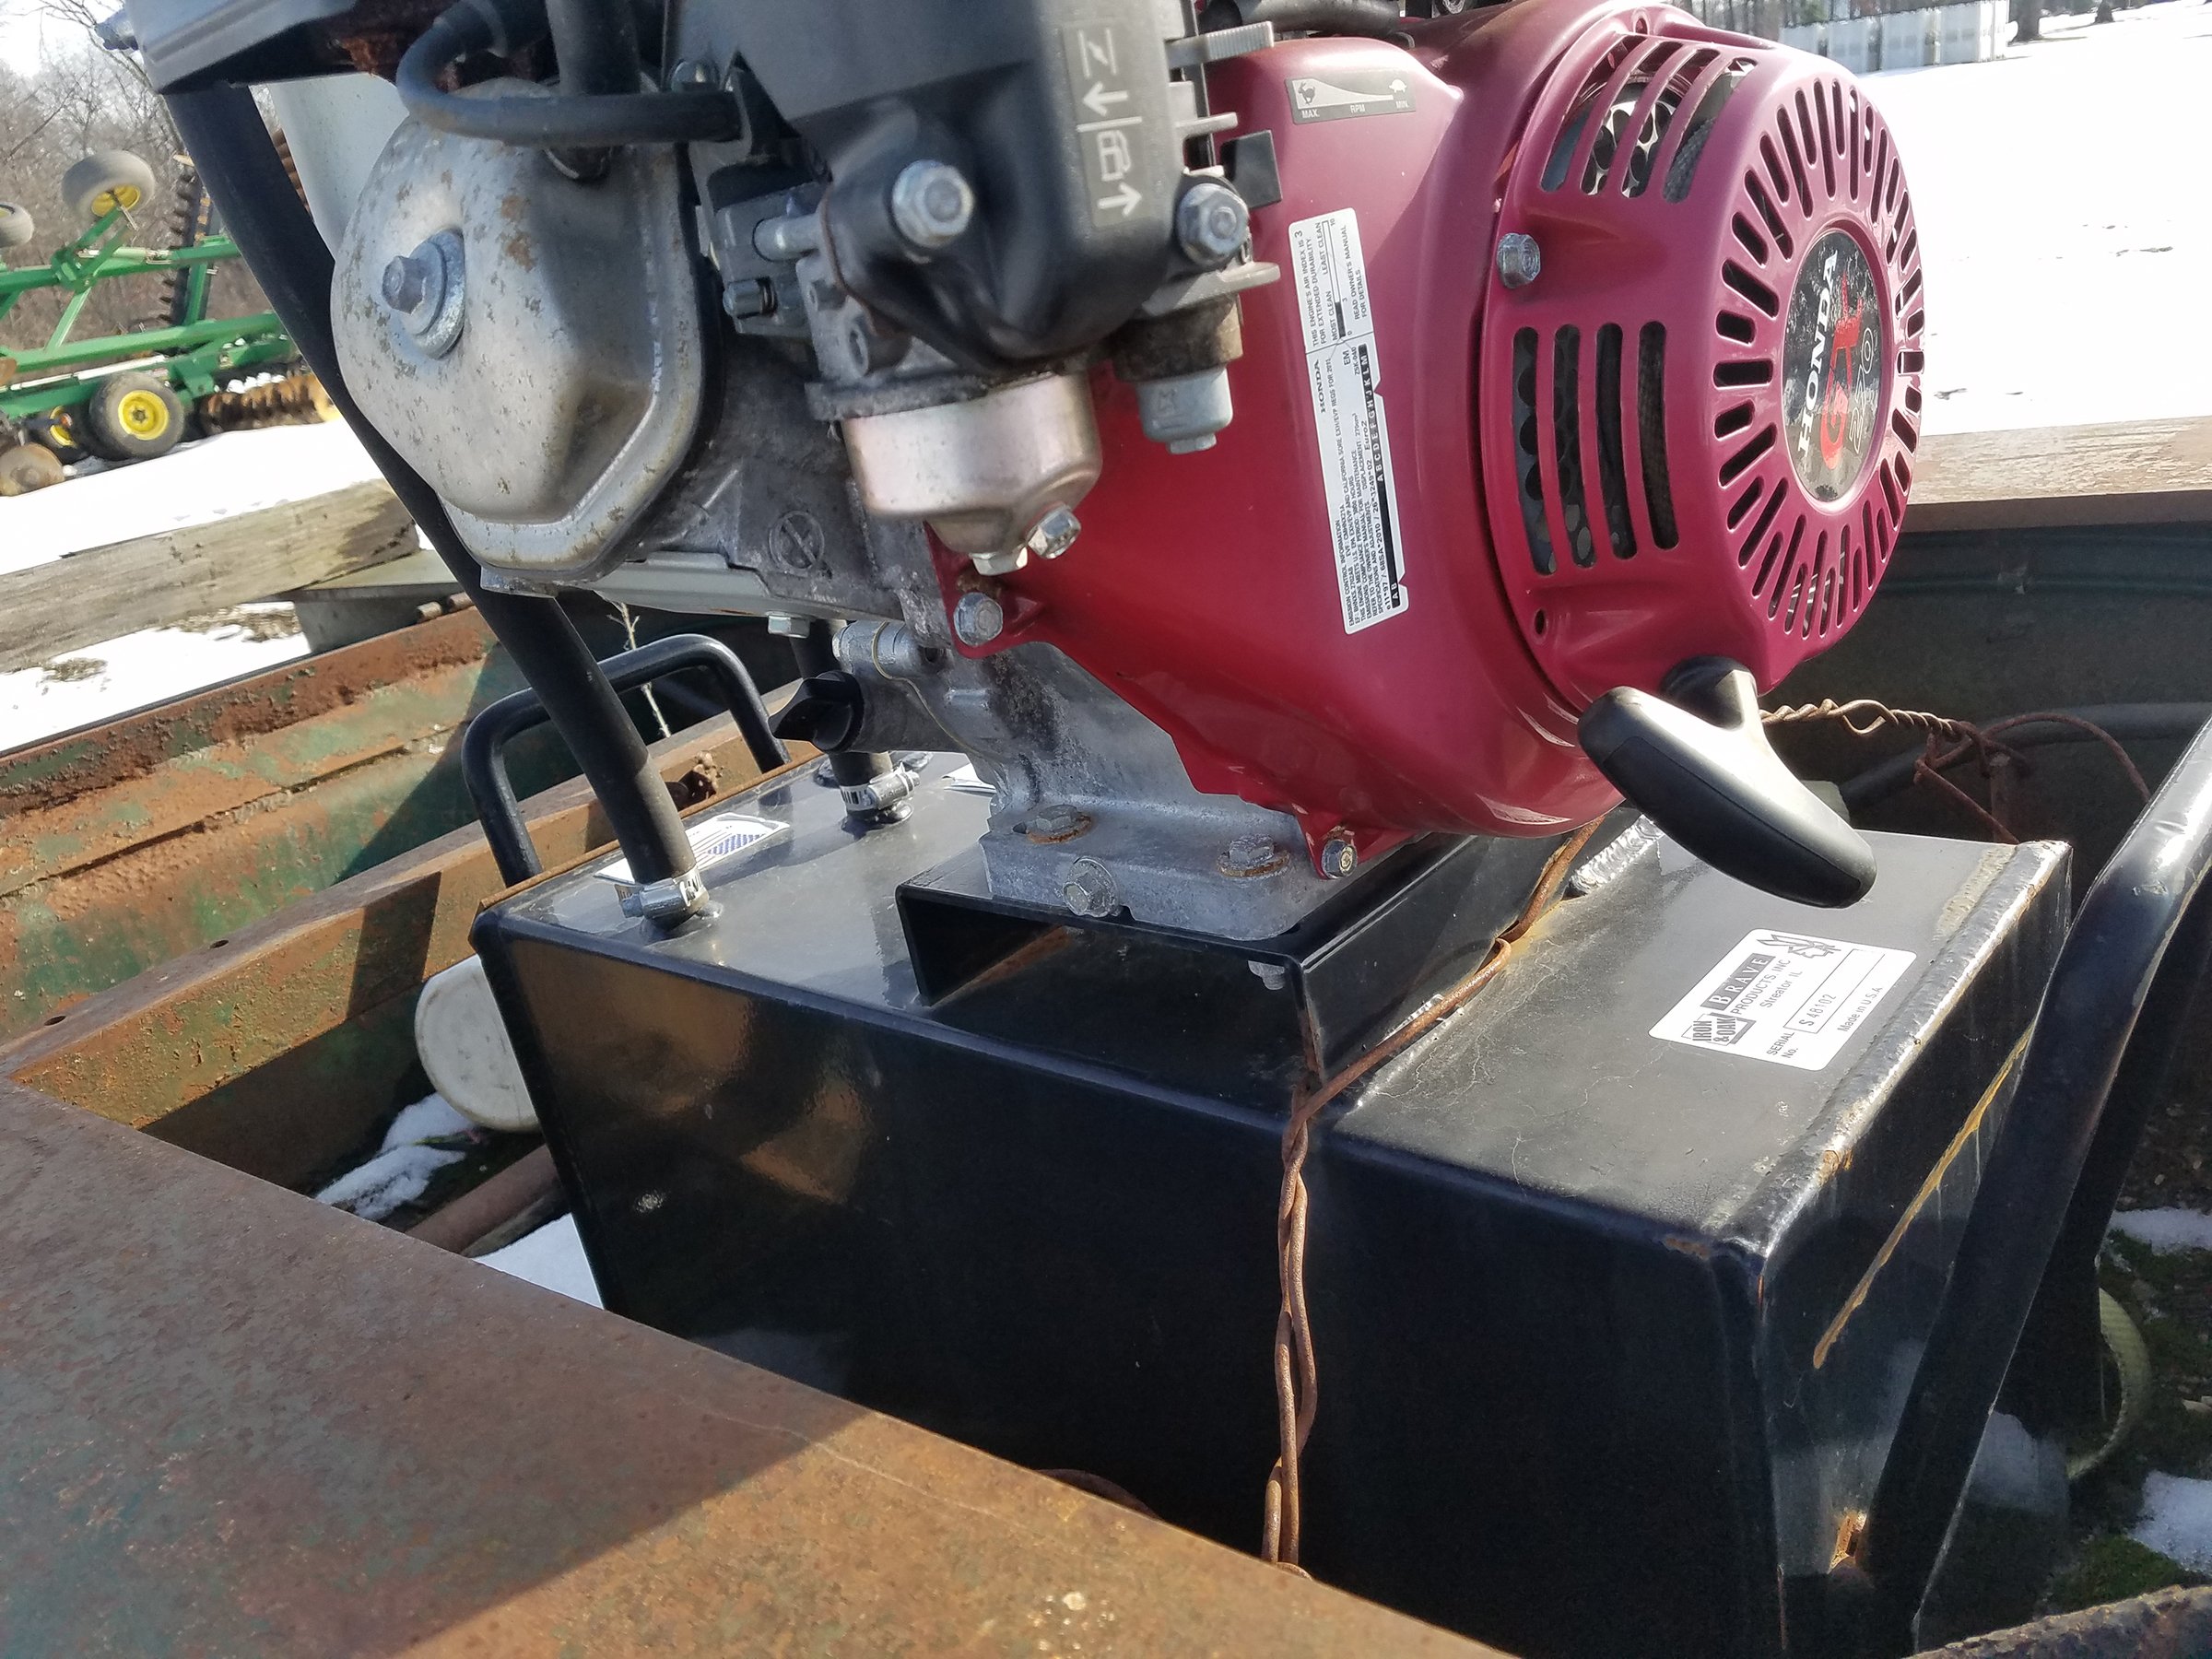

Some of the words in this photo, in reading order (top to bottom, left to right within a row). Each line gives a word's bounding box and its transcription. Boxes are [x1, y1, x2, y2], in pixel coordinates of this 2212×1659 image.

[1301, 109, 1320, 119] MAX.
[1350, 104, 1366, 113] RPM
[1315, 222, 1324, 248] CLEAN
[1340, 225, 1350, 260] MANUAL
[1300, 250, 1308, 274] INDEX
[1319, 250, 1328, 275] LEAST
[1347, 262, 1357, 298] OWNER'S
[1305, 290, 1316, 327] ENGINE'S
[1313, 286, 1324, 326] EXTENDED
[1325, 290, 1335, 316] CLEAN
[1352, 299, 1360, 320] READ
[1342, 349, 1351, 366] EM
[1360, 355, 1368, 366] M
[1798, 250, 1838, 457] HONDA
[1313, 359, 1326, 414] HONDA
[1364, 378, 1371, 386] K
[1367, 400, 1373, 408] H
[1368, 410, 1375, 418] G
[1360, 419, 1371, 452] Euro2
[1372, 442, 1380, 452] D
[1374, 453, 1381, 461] C
[1375, 464, 1382, 472] B
[1339, 456, 1348, 493] CALIFORNIA
[1351, 450, 1362, 498] MAINTENANCE
[1377, 474, 1383, 483] A
[1359, 512, 1368, 542] MANUAL
[1335, 519, 1346, 564] INFORMATION
[1357, 543, 1368, 583] COMPLIANCE
[1341, 565, 1350, 595] CONTROL
[1370, 586, 1375, 596] TO
[1372, 565, 1384, 614] SPECIFICATIONS
[1363, 584, 1372, 619] EMISSIONS
[1392, 592, 1398, 600] A
[1346, 595, 1355, 627] EMISSION
[1771, 959, 1791, 971] INC
[1709, 959, 1768, 1004] BRAVE
[1759, 981, 1792, 1007] Streator
[1692, 1020, 1712, 1041] IRON
[1766, 1032, 1794, 1055] SERIAL
[1806, 994, 1836, 1018] 48102
[1837, 1014, 1860, 1031] Made
[1781, 1048, 1798, 1058] No.
